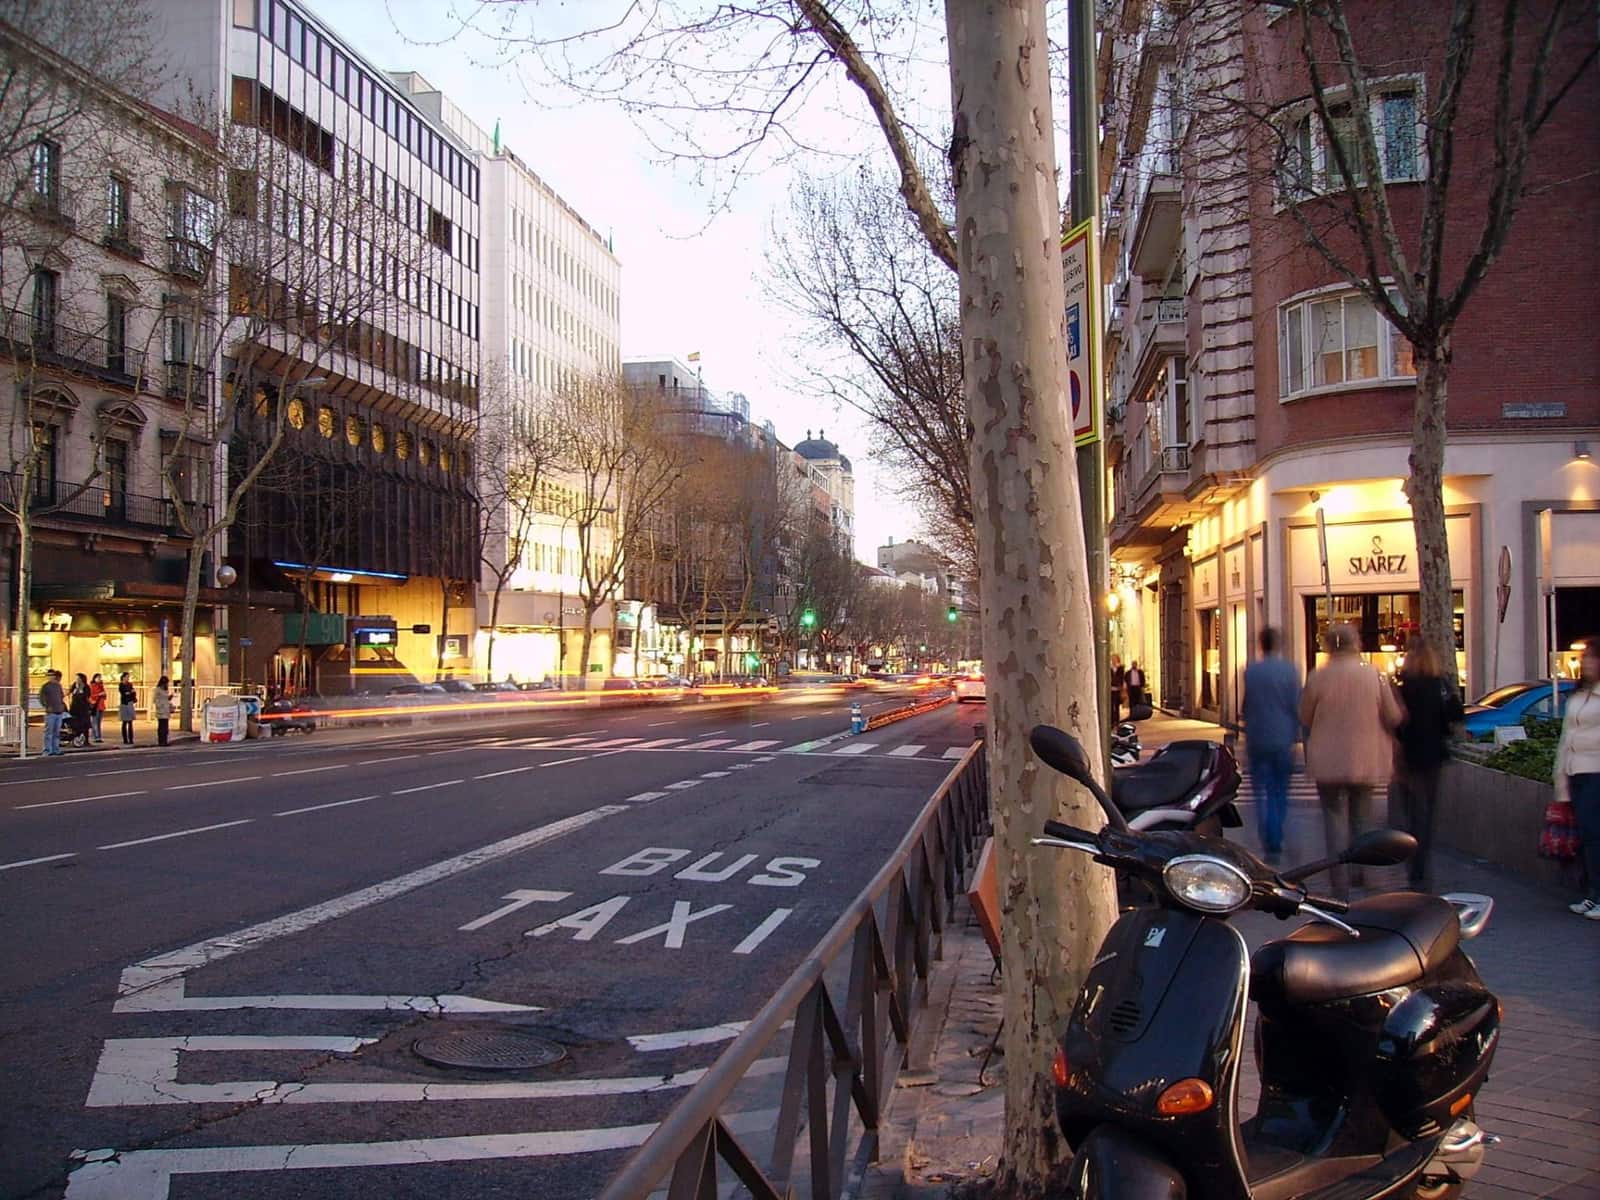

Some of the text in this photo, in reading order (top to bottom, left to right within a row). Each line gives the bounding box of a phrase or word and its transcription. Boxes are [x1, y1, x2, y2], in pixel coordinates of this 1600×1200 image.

[1349, 554, 1408, 576] SUAREZ
[598, 847, 822, 887] BUS
[458, 889, 793, 954] TAXI
